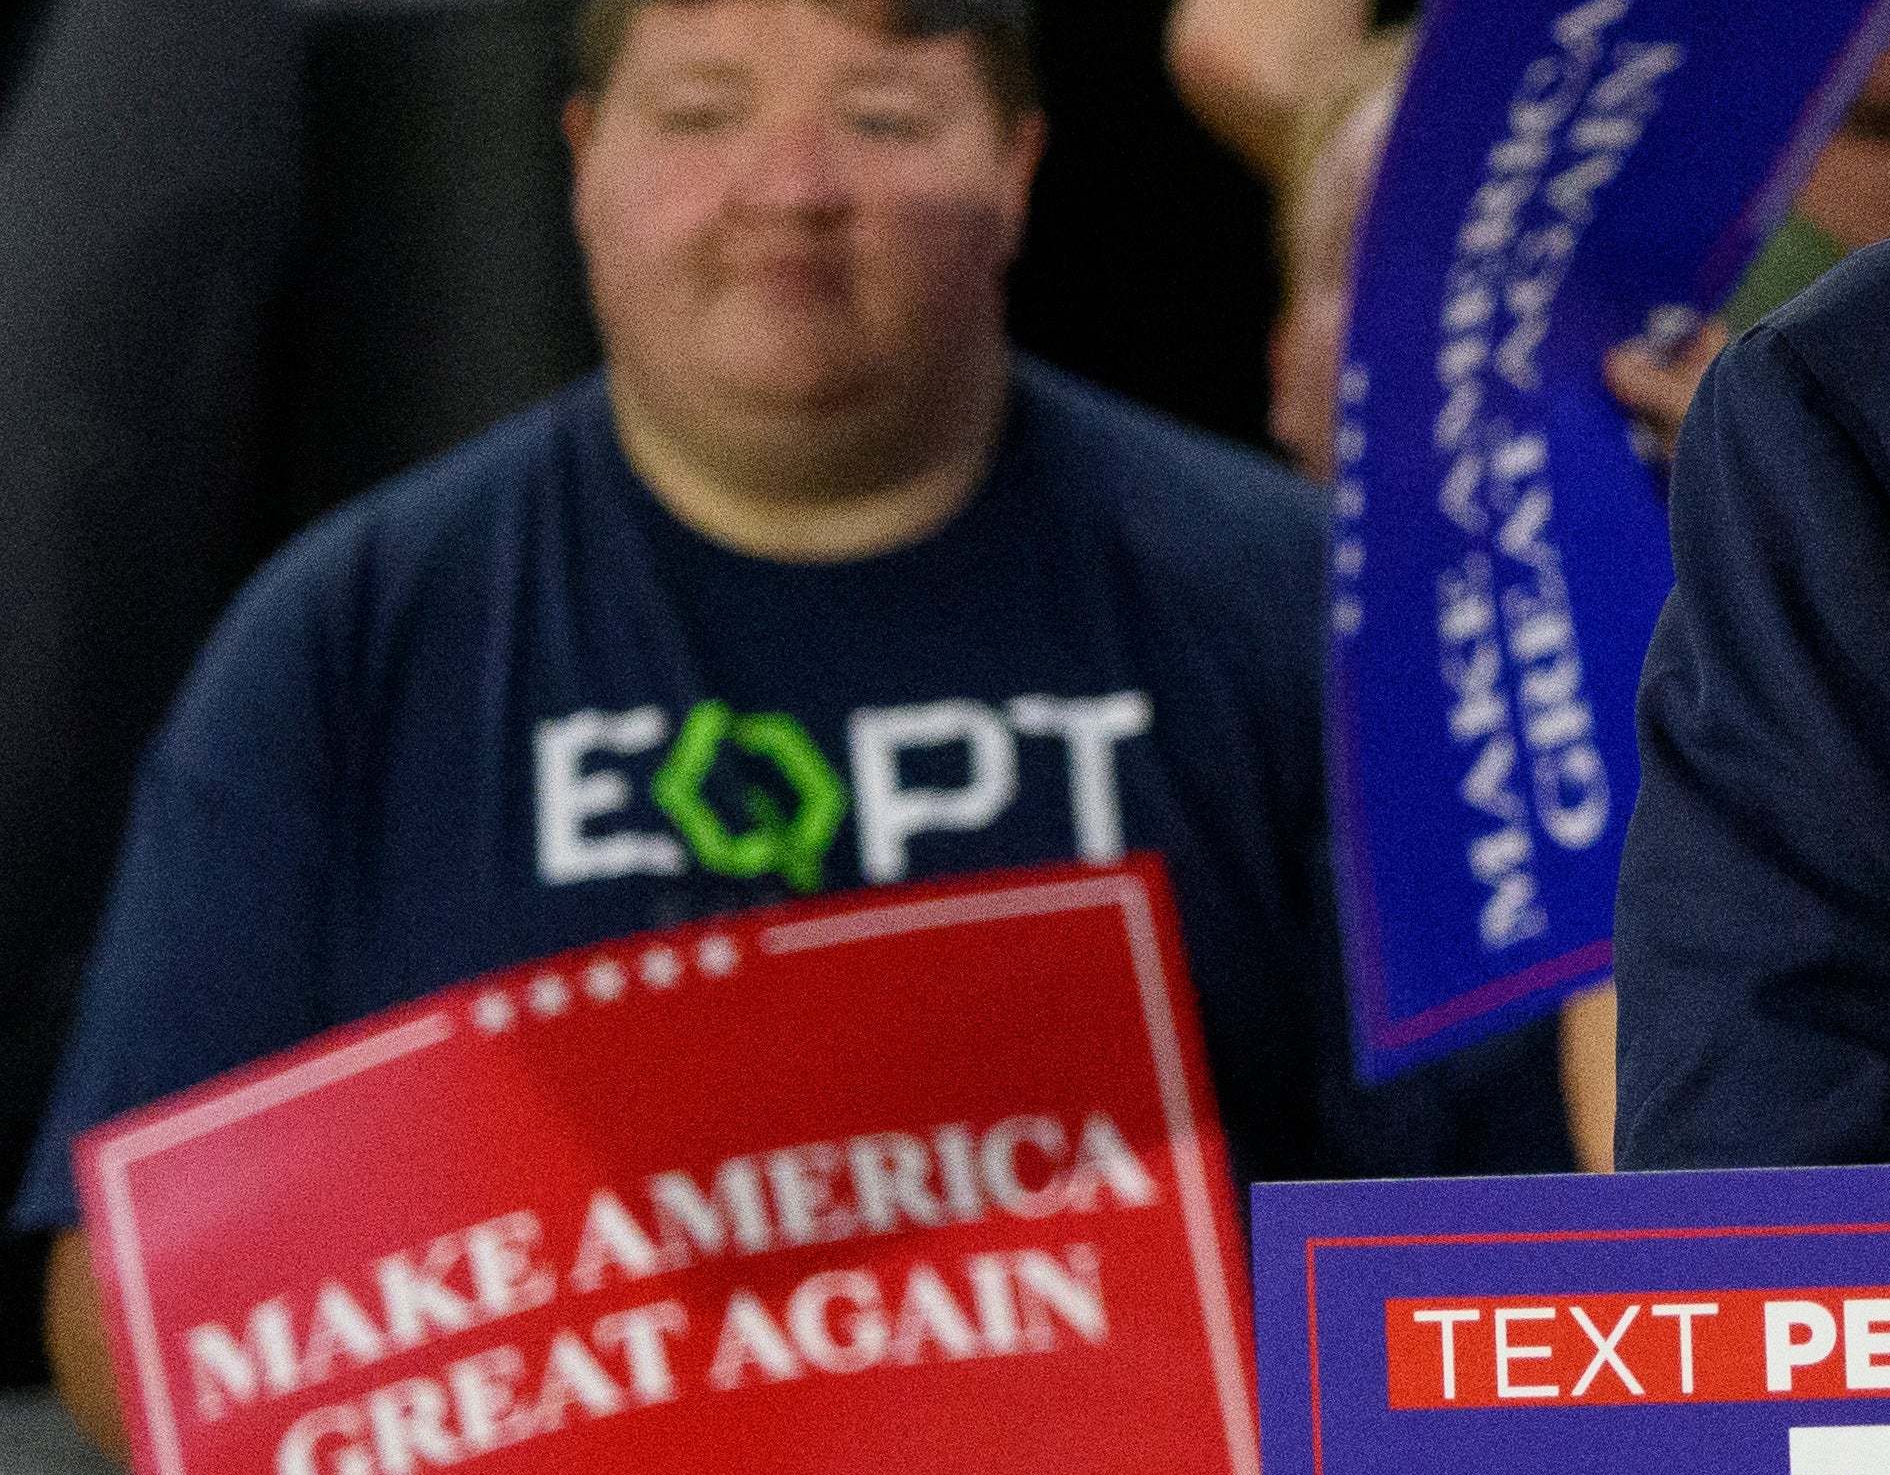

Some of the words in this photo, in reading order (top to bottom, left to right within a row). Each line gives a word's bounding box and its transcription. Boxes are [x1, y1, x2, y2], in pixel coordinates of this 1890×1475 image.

[1494, 38, 1686, 390] AGAIN
[533, 692, 1153, 892] EQPT
[1436, 550, 1548, 950] MAKE
[1490, 422, 1613, 854] GREAT
[188, 1210, 559, 1424] MAKE
[571, 1110, 1161, 1296] AMERICA
[711, 1242, 1109, 1393] AGAIN
[1413, 1301, 1720, 1402] TEXT
